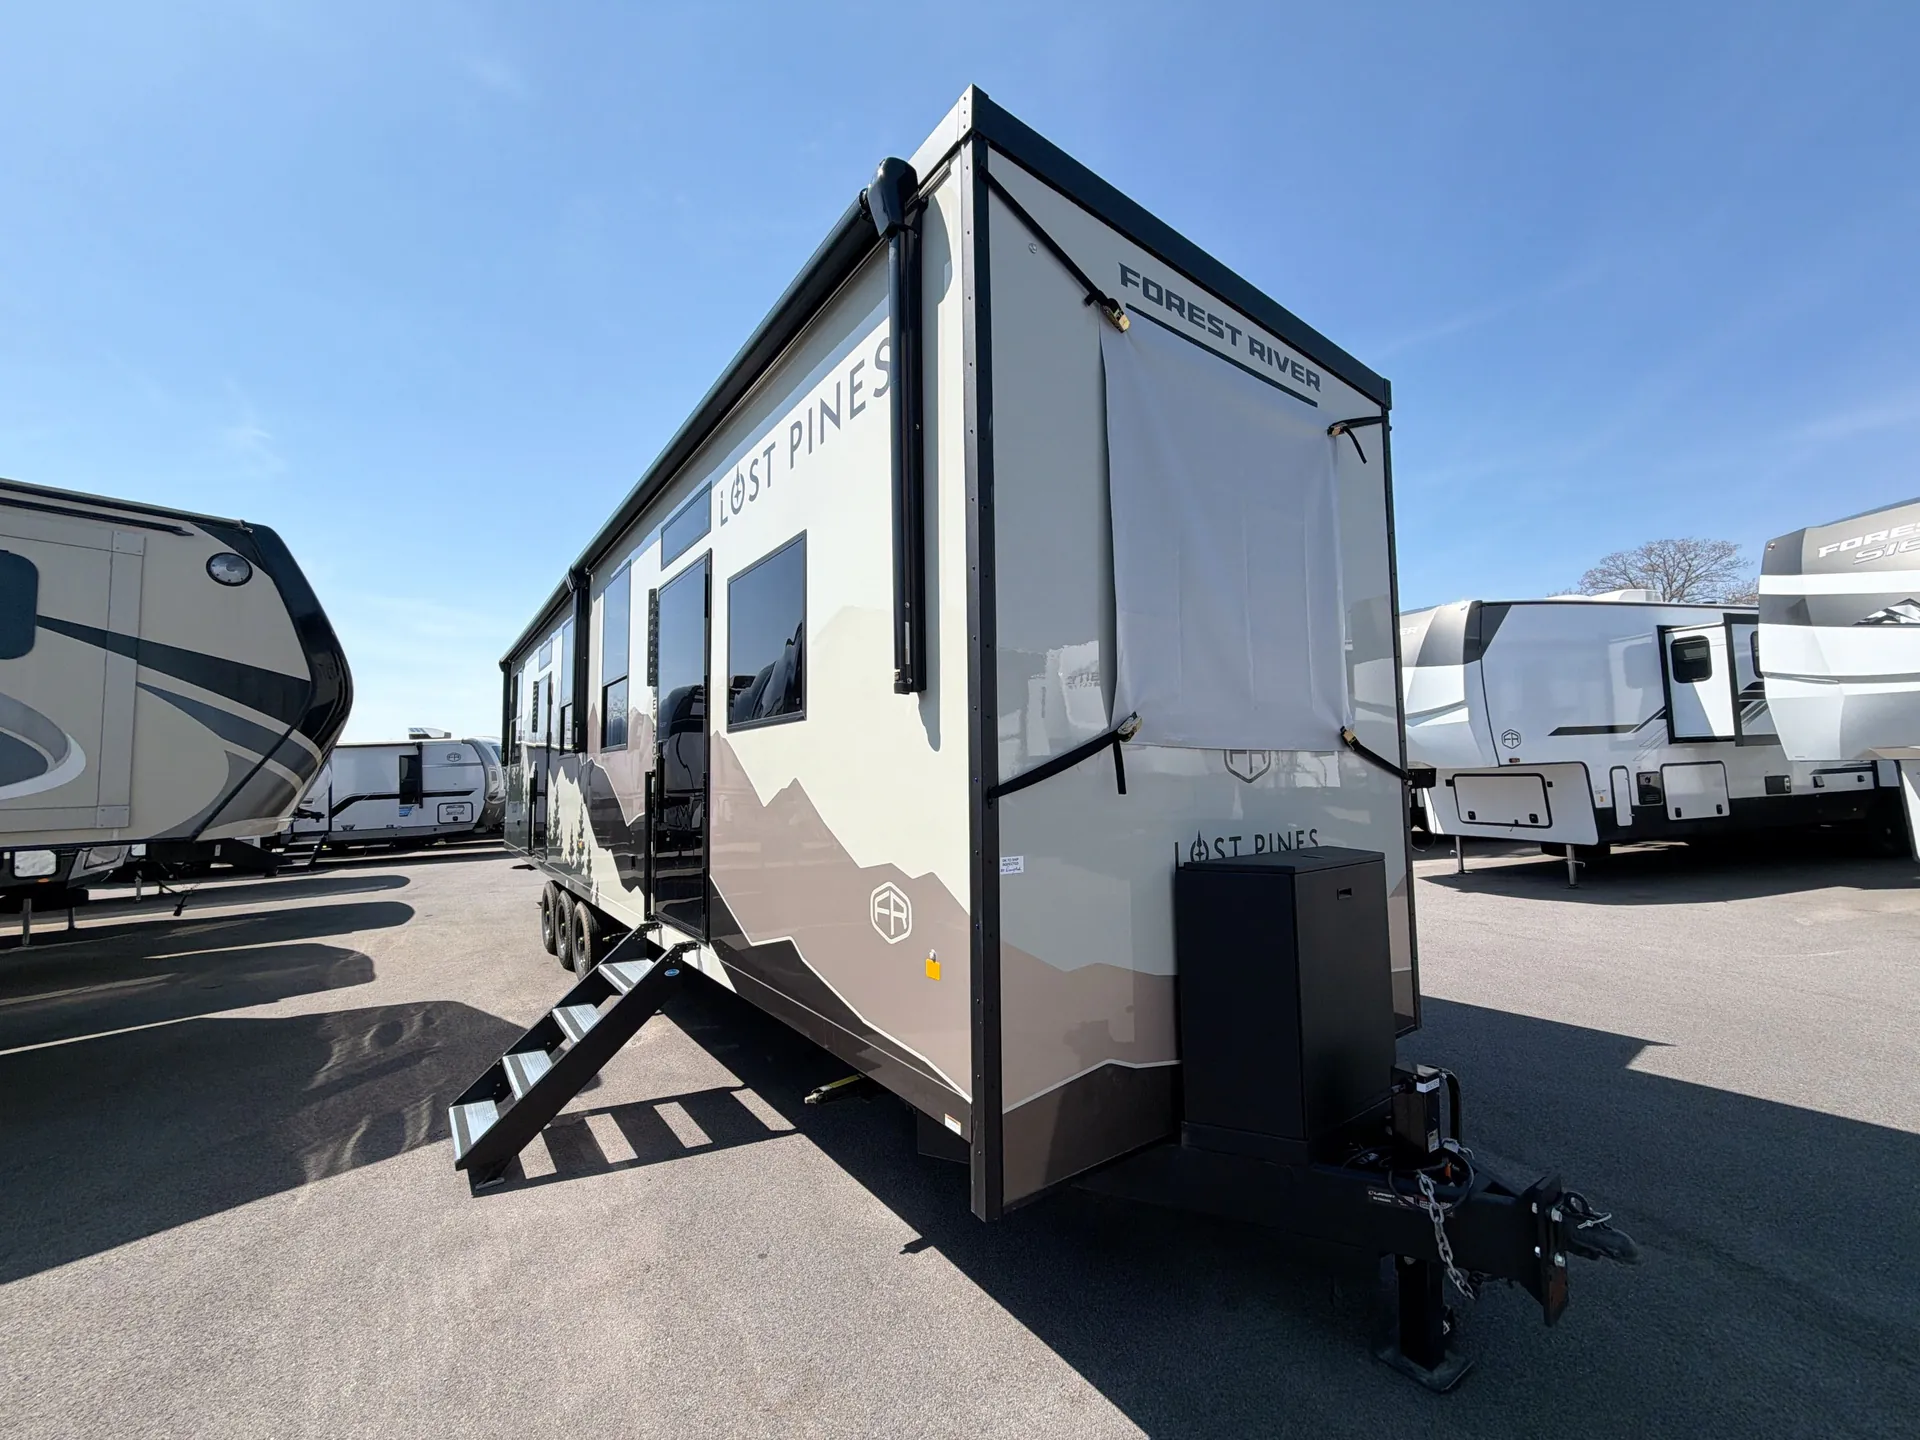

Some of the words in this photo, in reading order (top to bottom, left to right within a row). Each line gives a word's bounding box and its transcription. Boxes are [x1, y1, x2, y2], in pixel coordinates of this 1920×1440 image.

[1118, 262, 1242, 346] FOREST
[1248, 335, 1321, 392] RIVER
[720, 441, 776, 527] LOST
[790, 337, 891, 470] PINES
[1818, 522, 1920, 558] FORE
